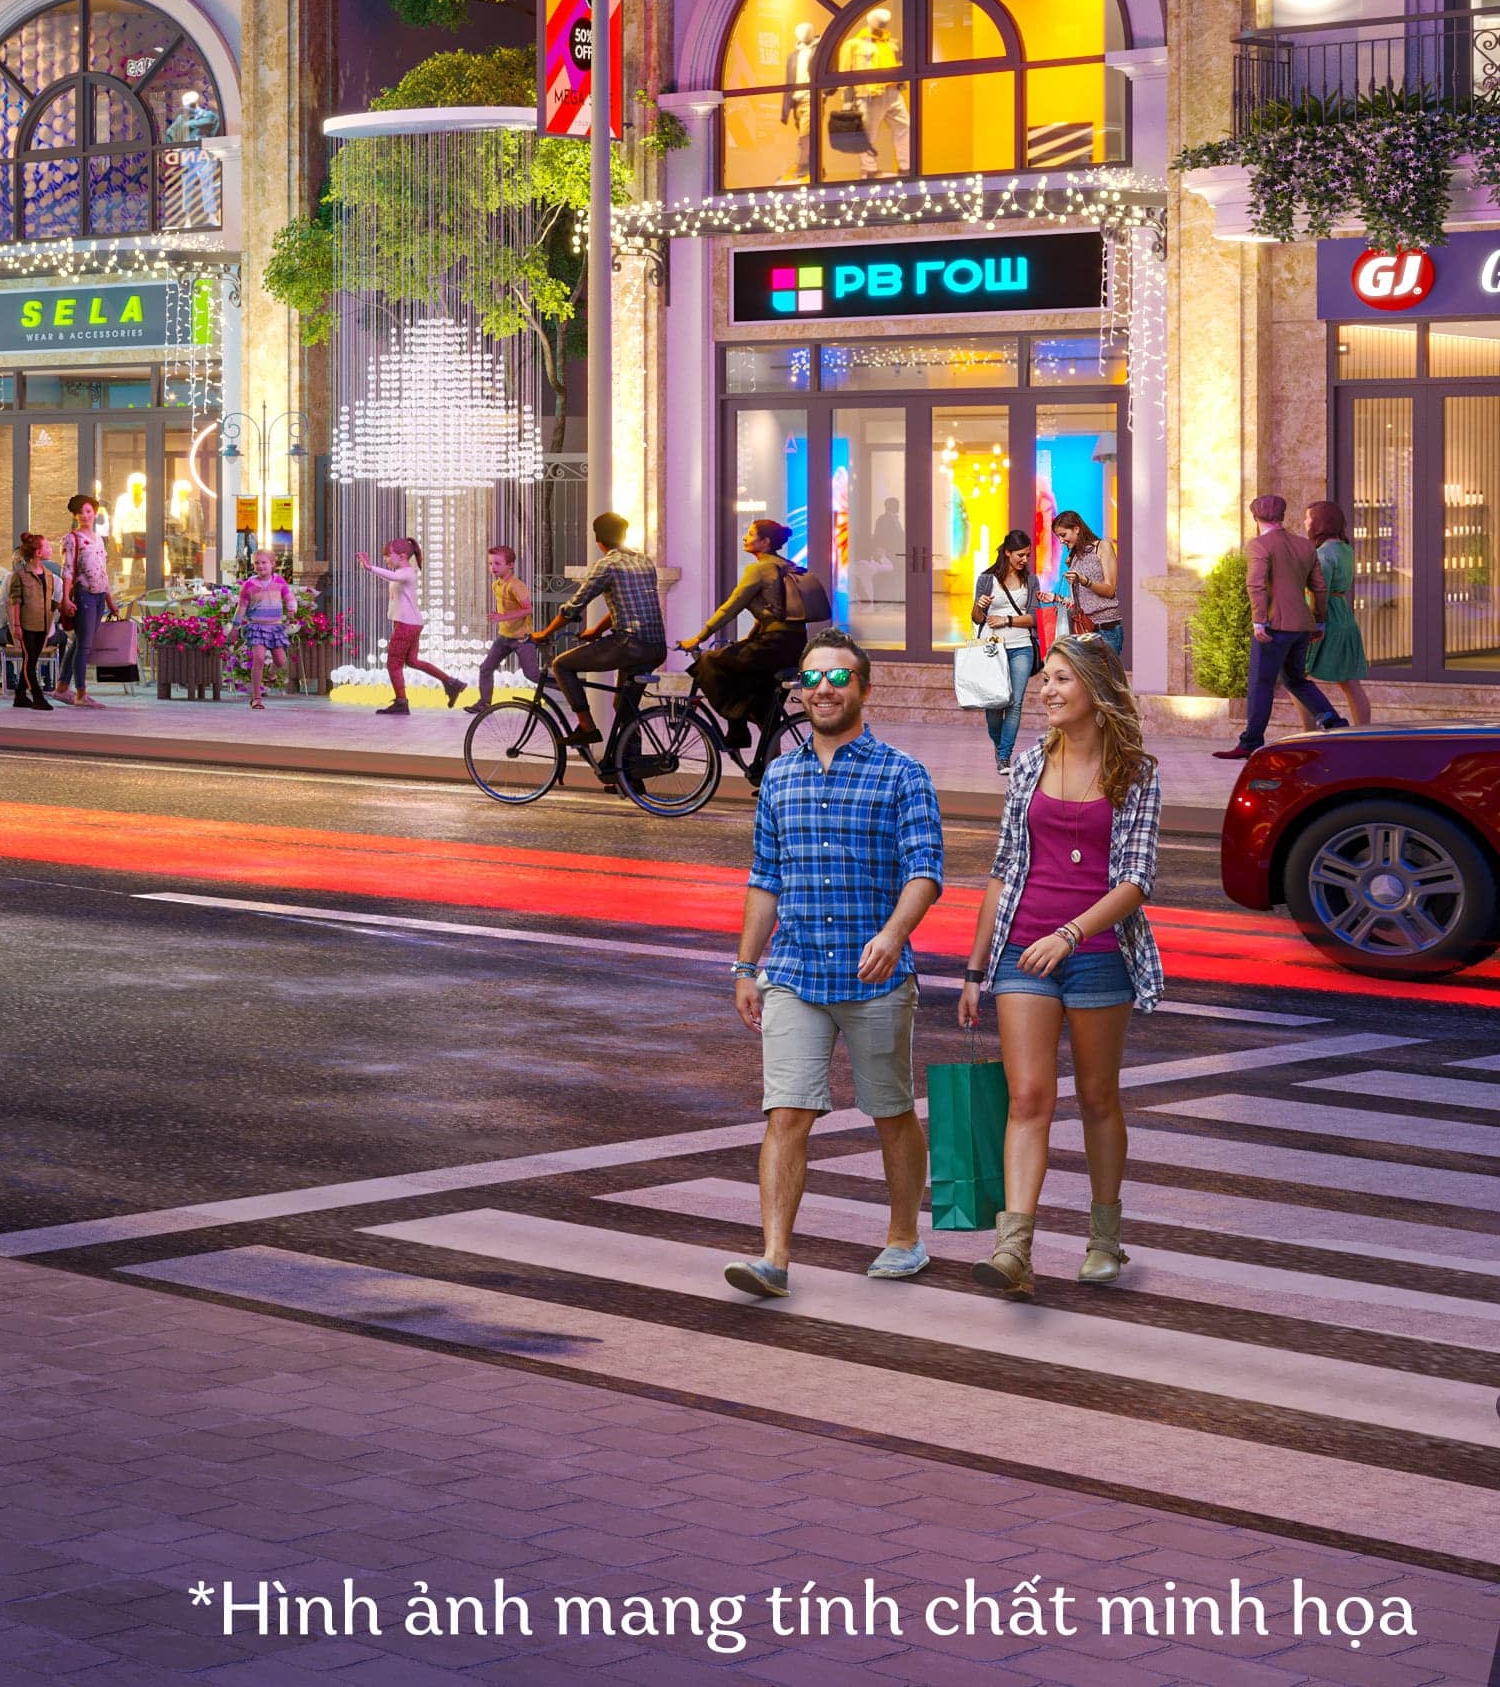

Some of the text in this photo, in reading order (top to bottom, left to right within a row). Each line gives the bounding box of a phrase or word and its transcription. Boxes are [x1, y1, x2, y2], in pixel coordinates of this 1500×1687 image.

[554, 88, 585, 106] MEGA
[19, 294, 144, 329] SELA
[26, 328, 144, 342] WEAR & ACCESSORIES
